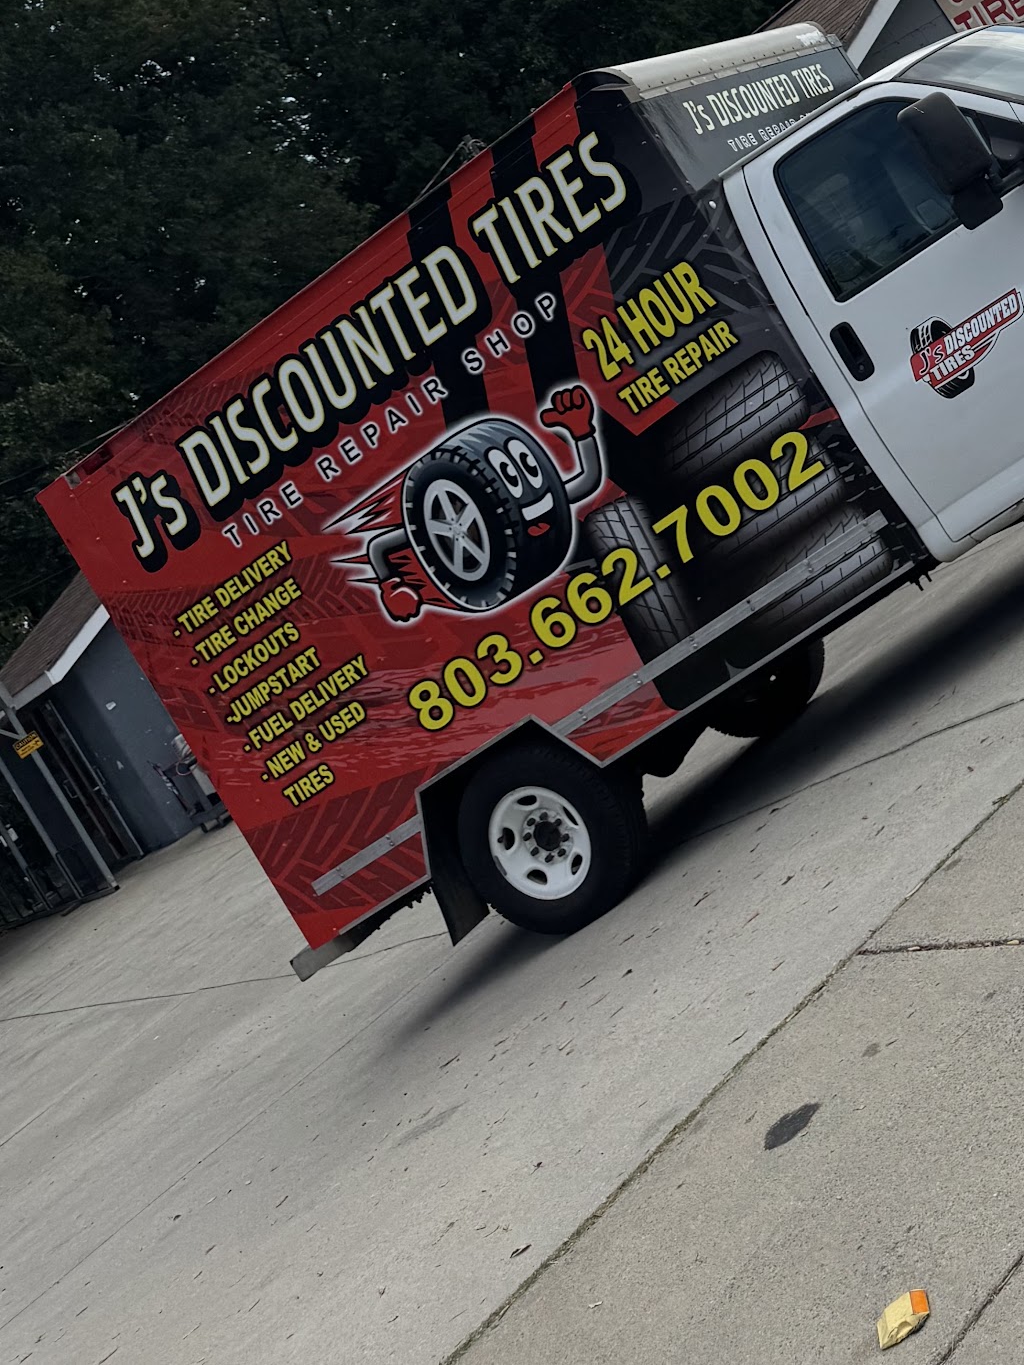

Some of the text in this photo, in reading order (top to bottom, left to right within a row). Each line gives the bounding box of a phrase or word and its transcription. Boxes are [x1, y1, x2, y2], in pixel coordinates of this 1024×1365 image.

[683, 64, 834, 135] J's DISCOUNTED TIRES
[727, 133, 758, 152] TIRE
[115, 131, 627, 558] J's DISCOUNTED TIRES
[582, 262, 717, 381] 24 HOUR
[929, 344, 975, 381] TIRES
[943, 294, 1018, 355] DISCOUNTED
[618, 321, 739, 414] TIRE REPAIR
[223, 293, 556, 547] TIRE REPAIR SHOP
[177, 540, 292, 634] TIRE DELIVERY
[194, 578, 302, 662] TIRE CHANGE
[408, 431, 825, 731] 803.662.7002
[213, 622, 300, 692] LOCKOUTS
[248, 655, 369, 749] FUEL DELIVERY
[266, 701, 366, 779] NEW & USED
[283, 764, 335, 807] TIRES
